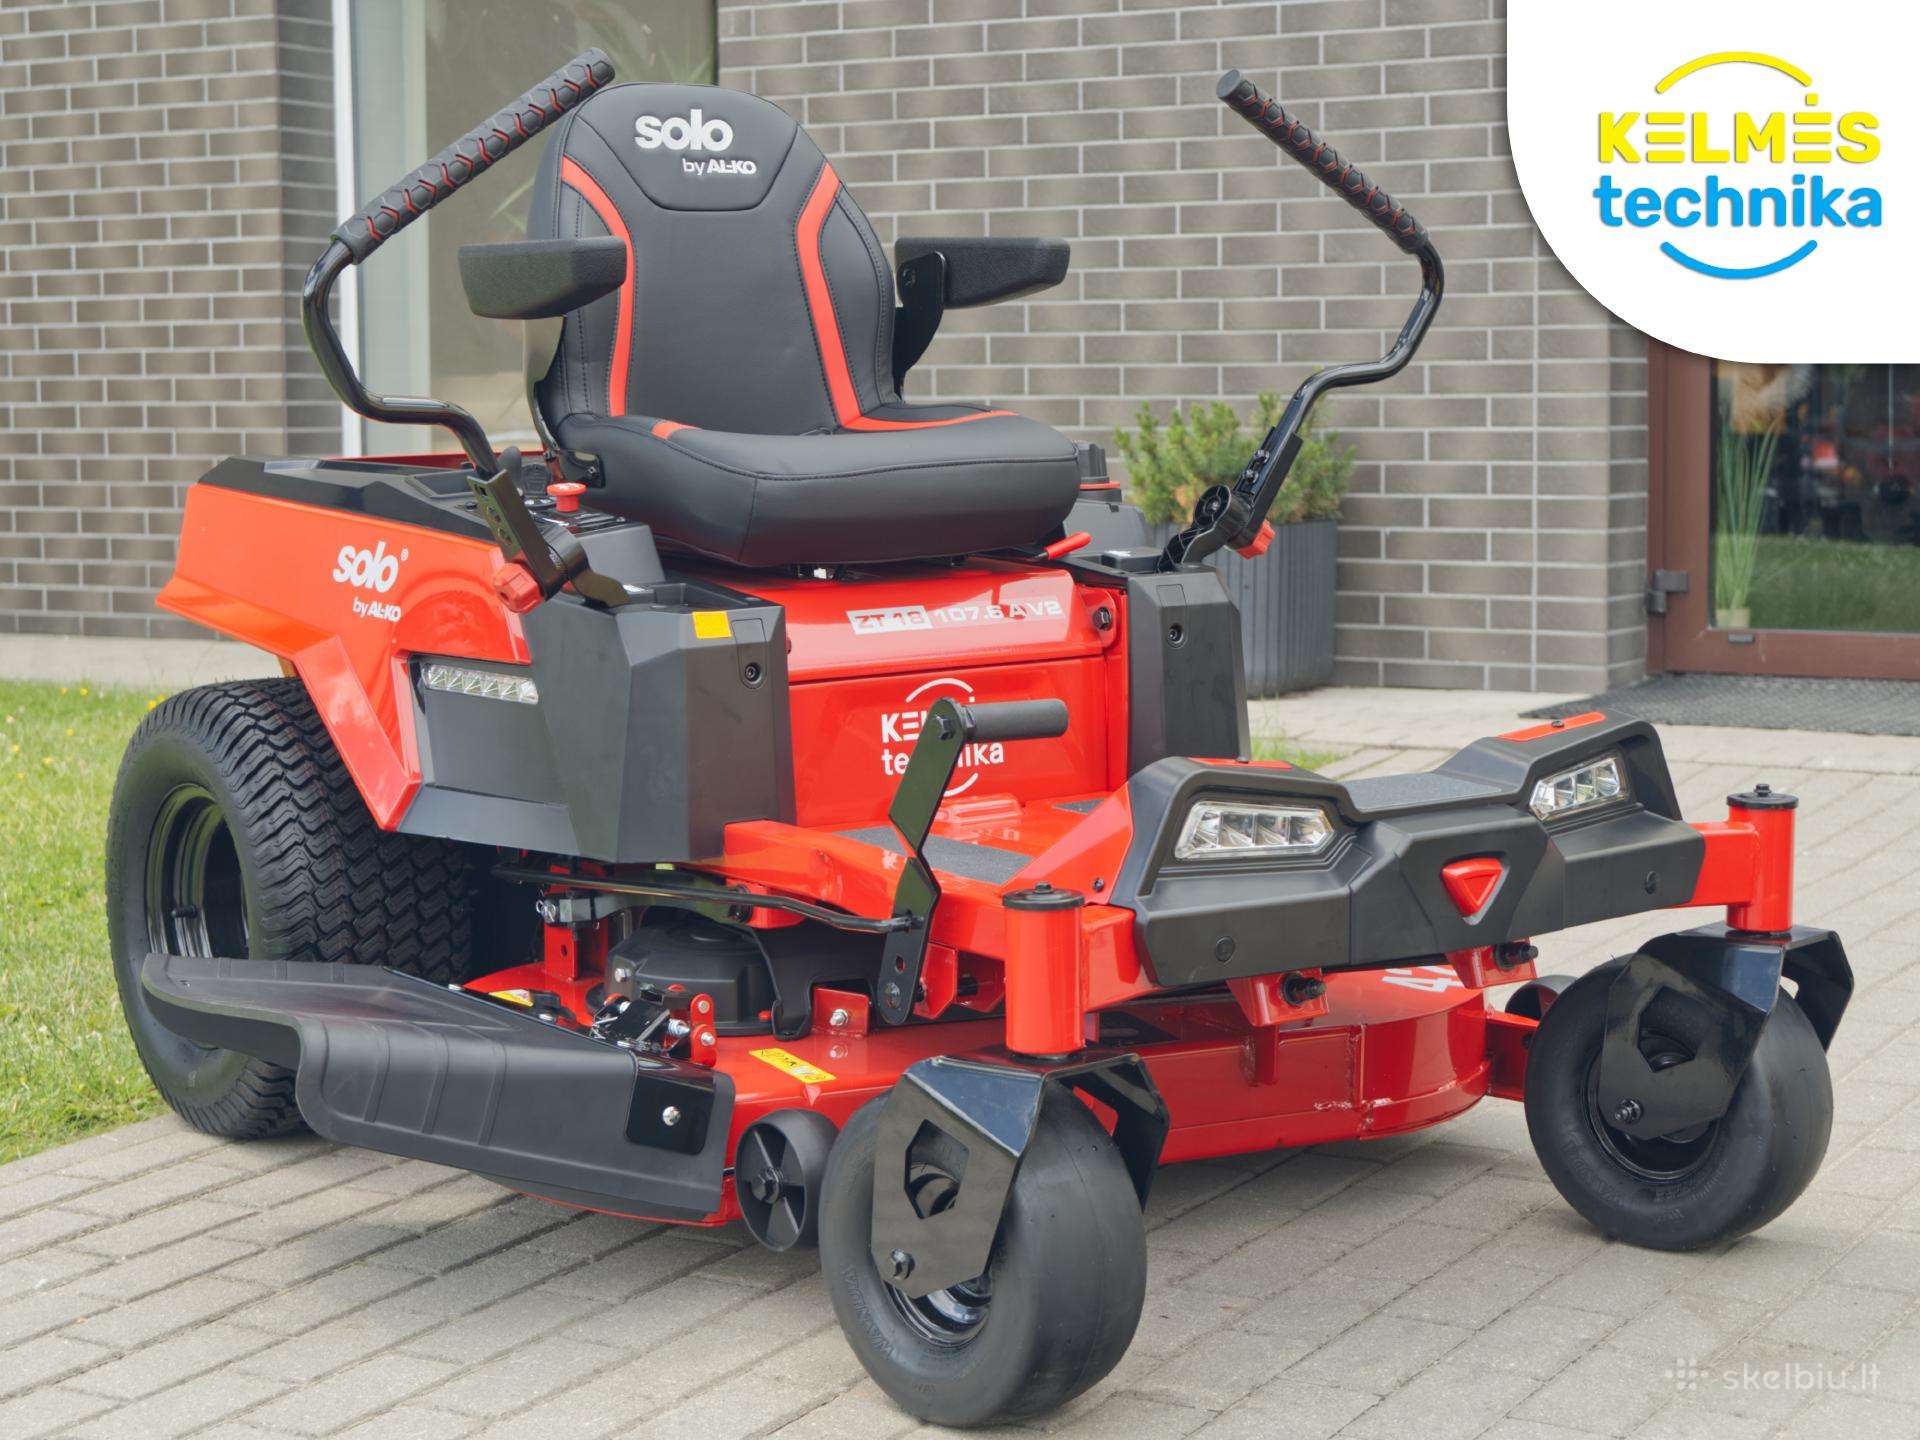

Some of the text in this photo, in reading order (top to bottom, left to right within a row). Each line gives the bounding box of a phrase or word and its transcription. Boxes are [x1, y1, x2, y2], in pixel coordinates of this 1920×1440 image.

[634, 108, 734, 152] solo
[682, 158, 757, 176] by AL-KO
[352, 596, 369, 618] by
